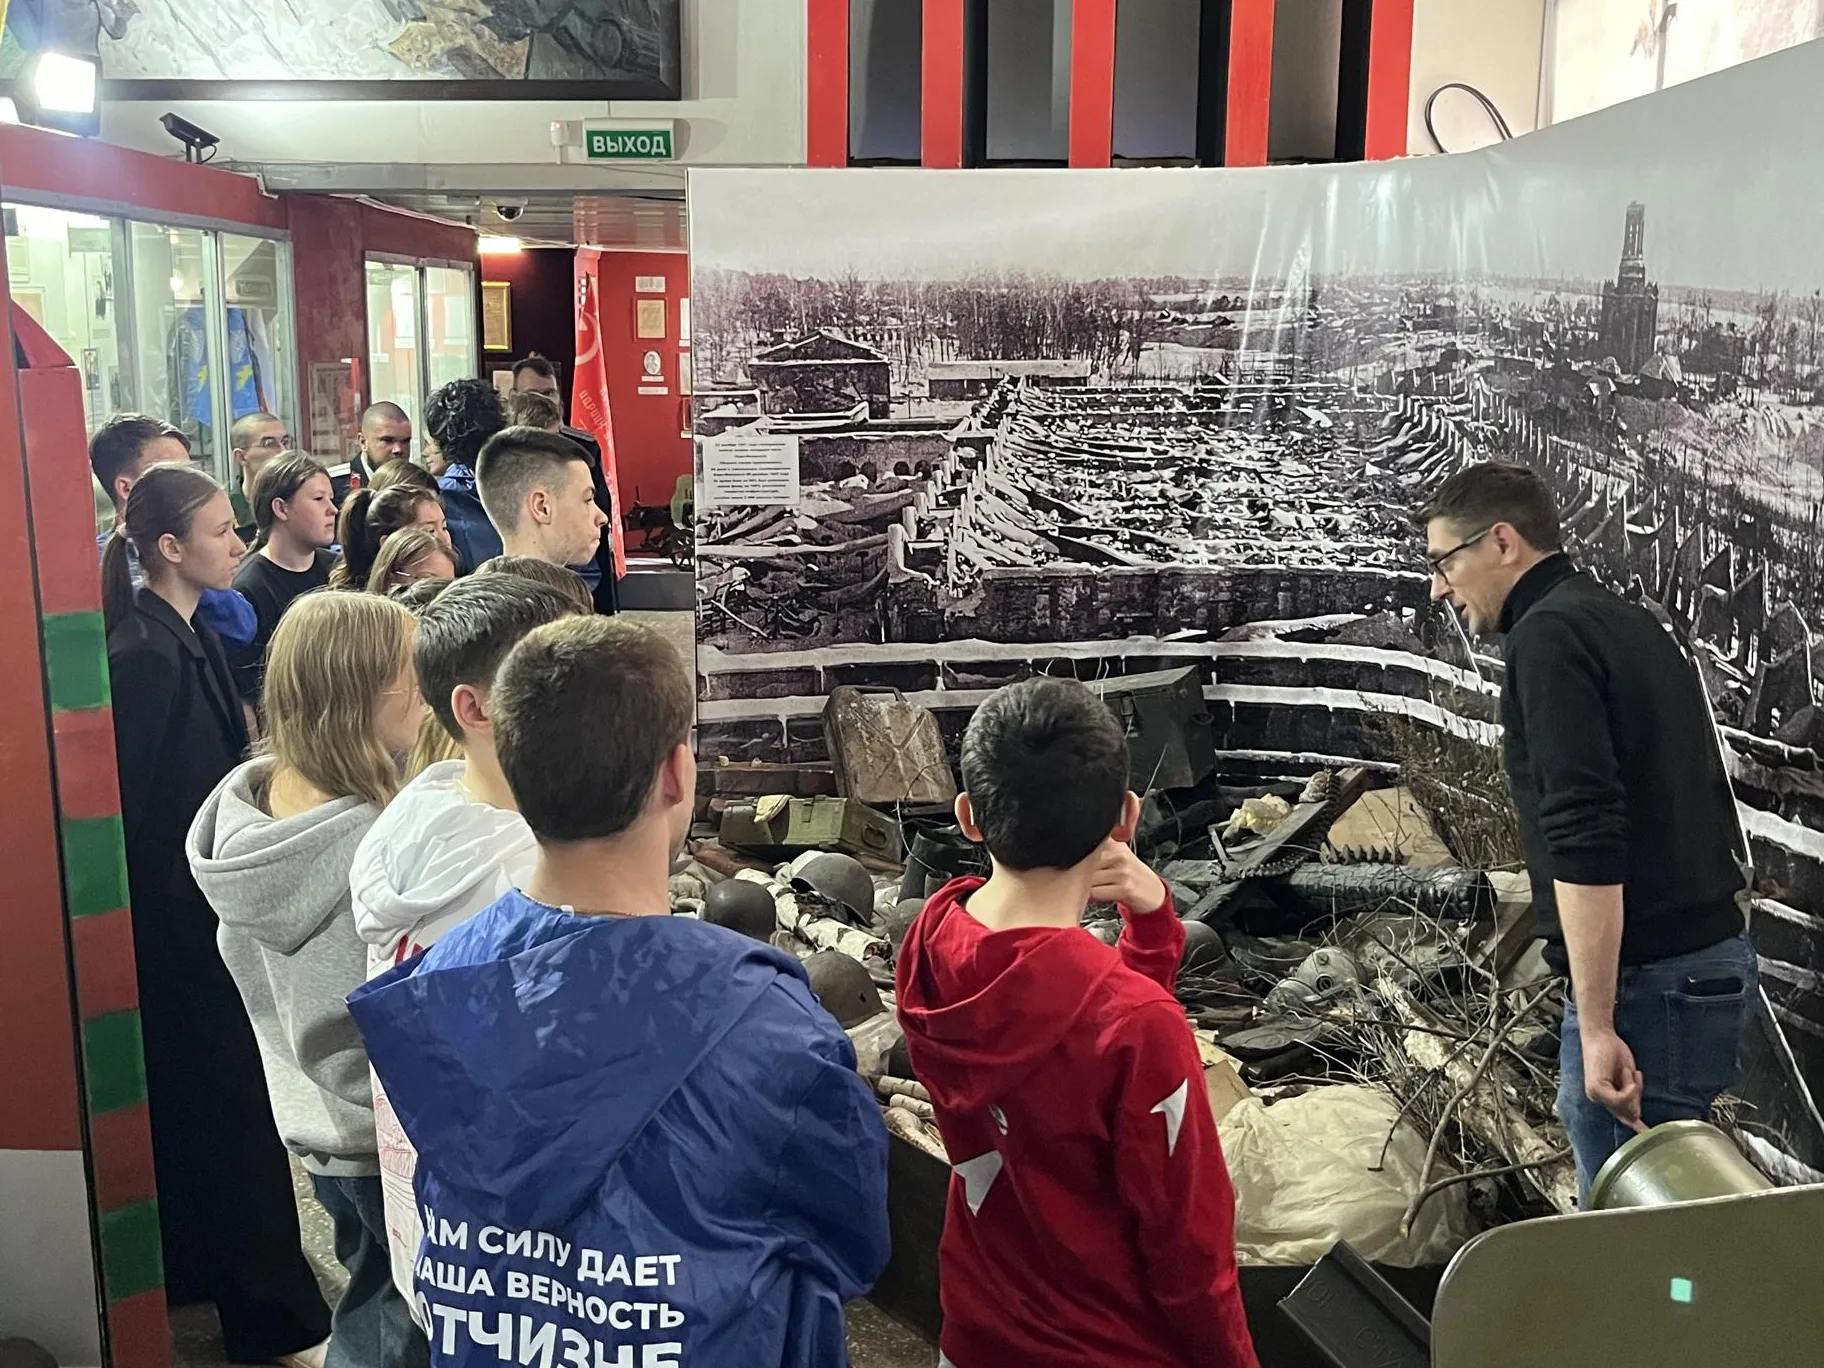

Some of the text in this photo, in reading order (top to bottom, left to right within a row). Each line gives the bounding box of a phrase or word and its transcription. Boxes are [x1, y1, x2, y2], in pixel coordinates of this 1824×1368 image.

[592, 135, 667, 156] ВЫХОД
[478, 1225, 572, 1267] СИЛУ
[577, 1248, 682, 1287] ДАЕТ
[506, 1270, 685, 1330] ВЕРНОСТЬ
